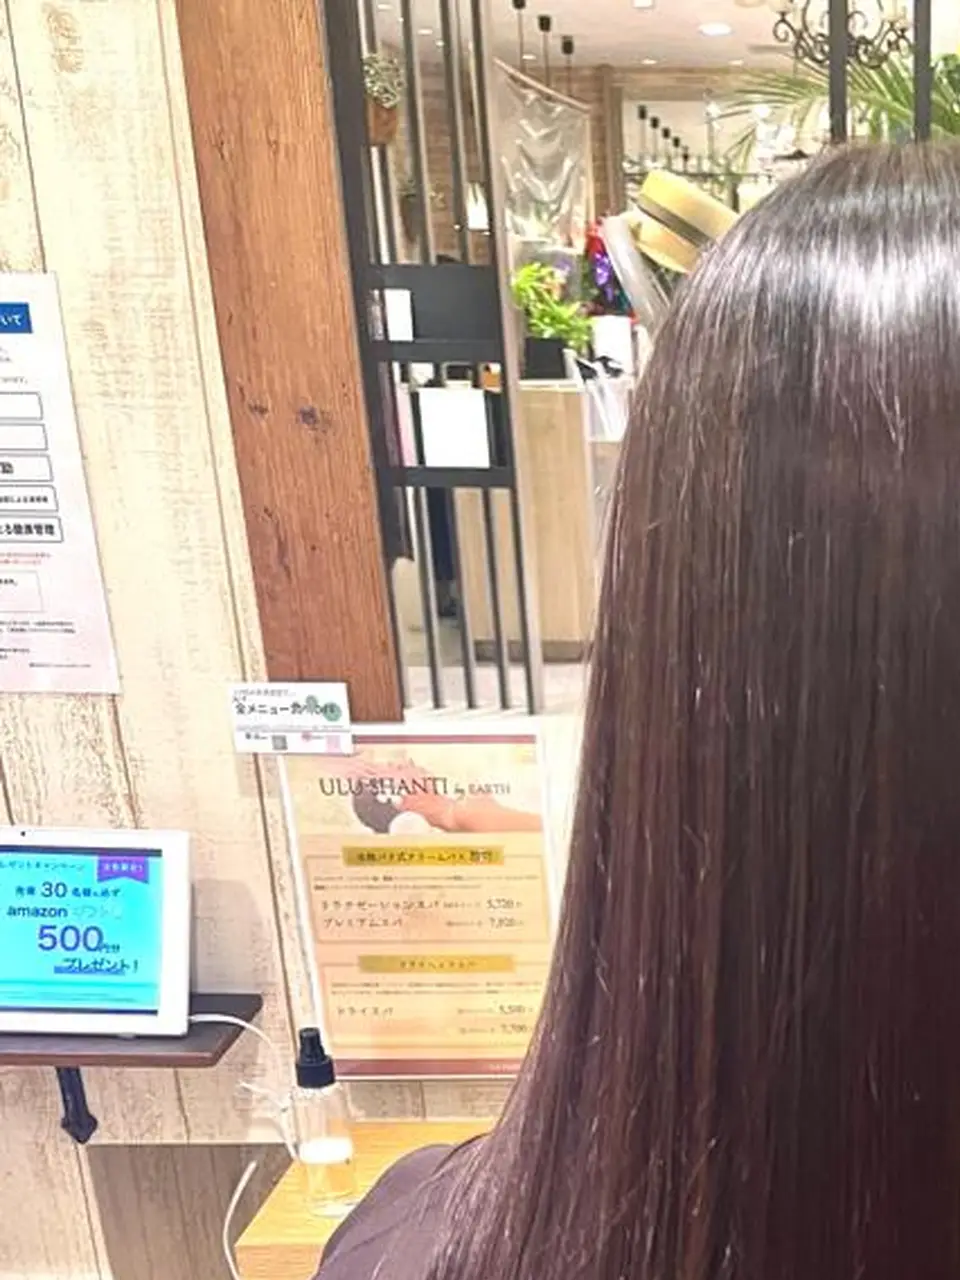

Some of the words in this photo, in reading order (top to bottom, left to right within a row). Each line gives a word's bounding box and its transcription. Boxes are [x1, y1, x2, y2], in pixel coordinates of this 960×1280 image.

[467, 783, 511, 795] EARTH
[41, 881, 68, 897] 30
[7, 905, 68, 918] amazon
